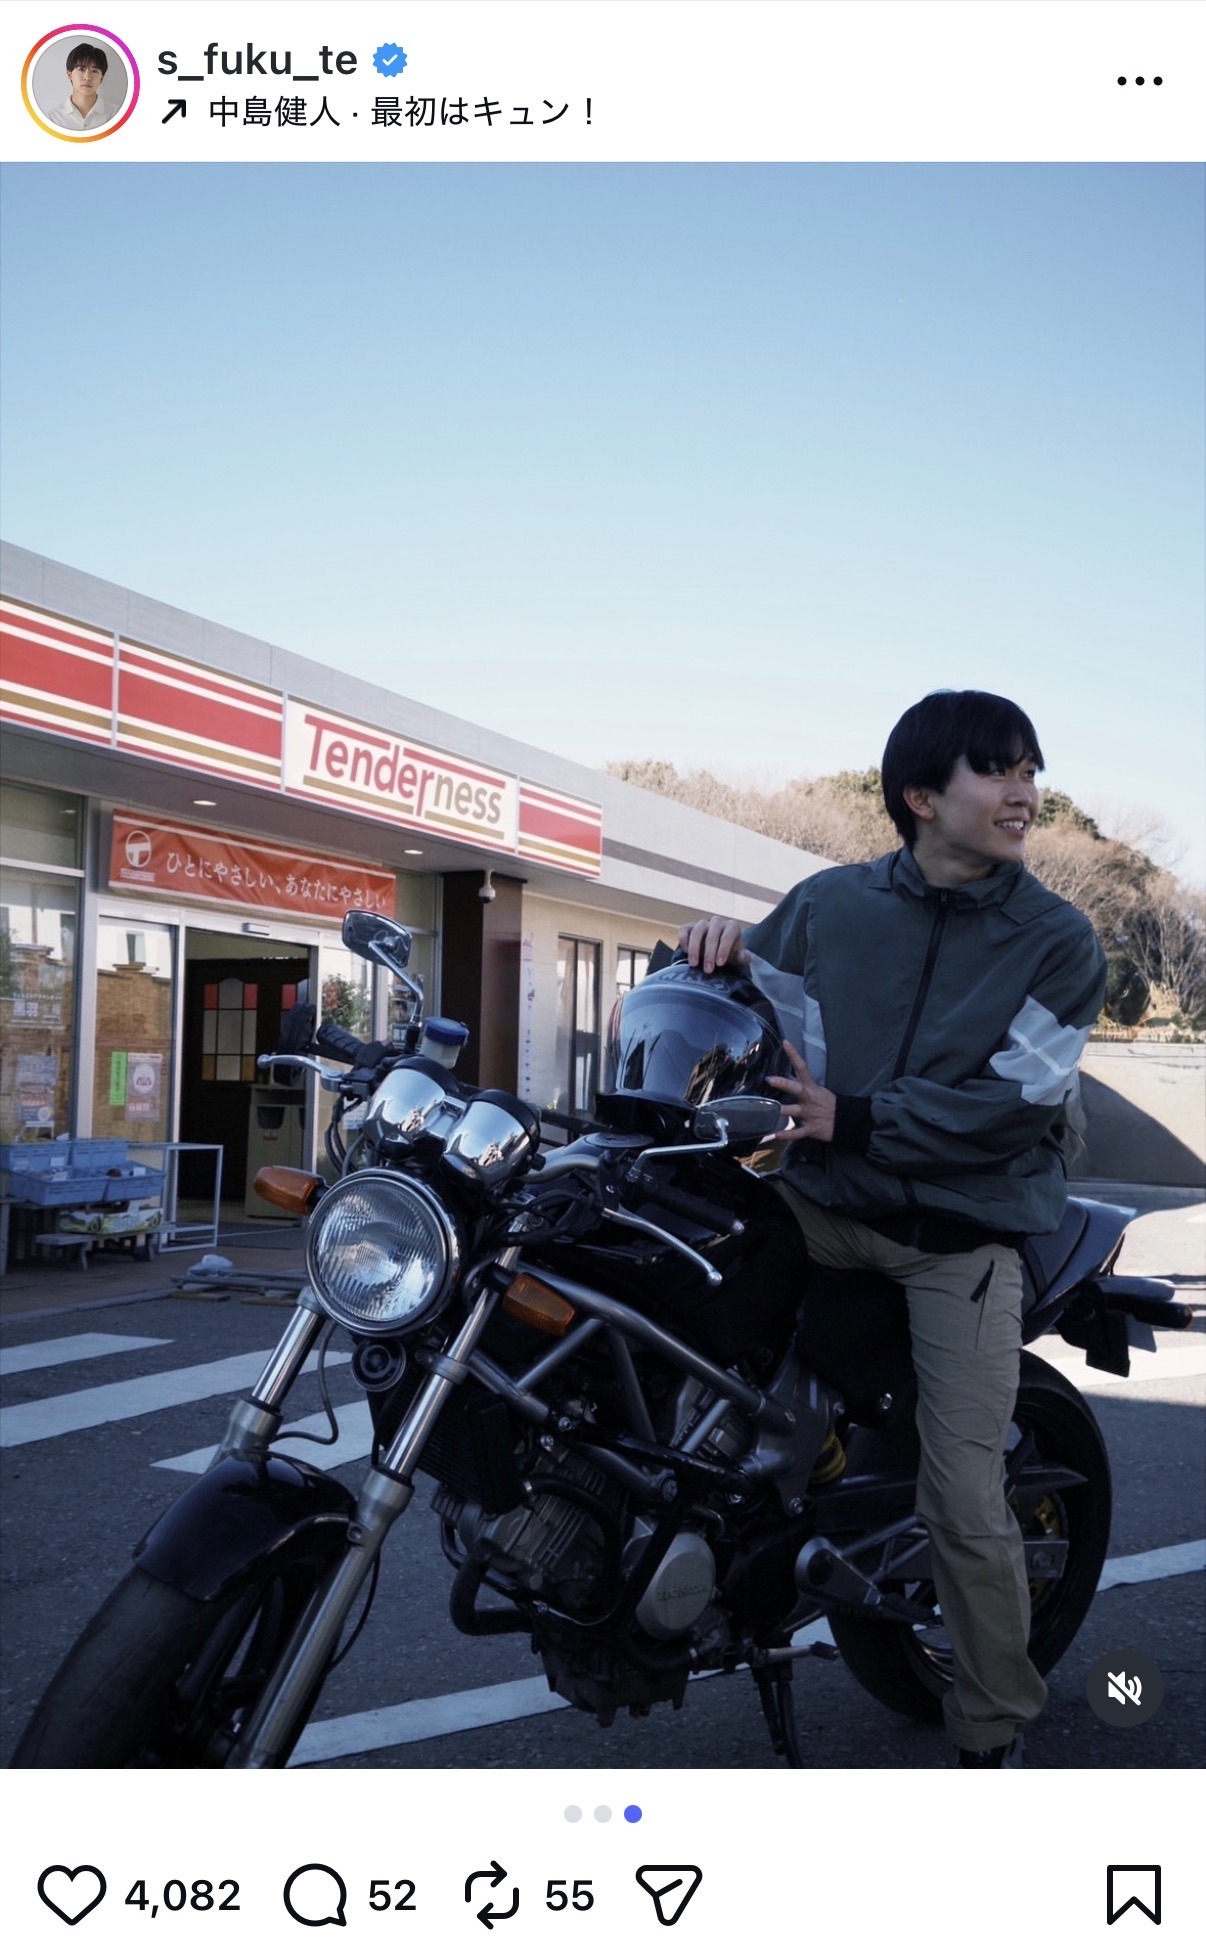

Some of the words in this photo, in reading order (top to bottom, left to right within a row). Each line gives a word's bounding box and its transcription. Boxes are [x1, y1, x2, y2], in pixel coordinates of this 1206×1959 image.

[304, 713, 503, 824] Tenderness
[166, 852, 387, 909] ひとにやさしい、あなたにやさしい
